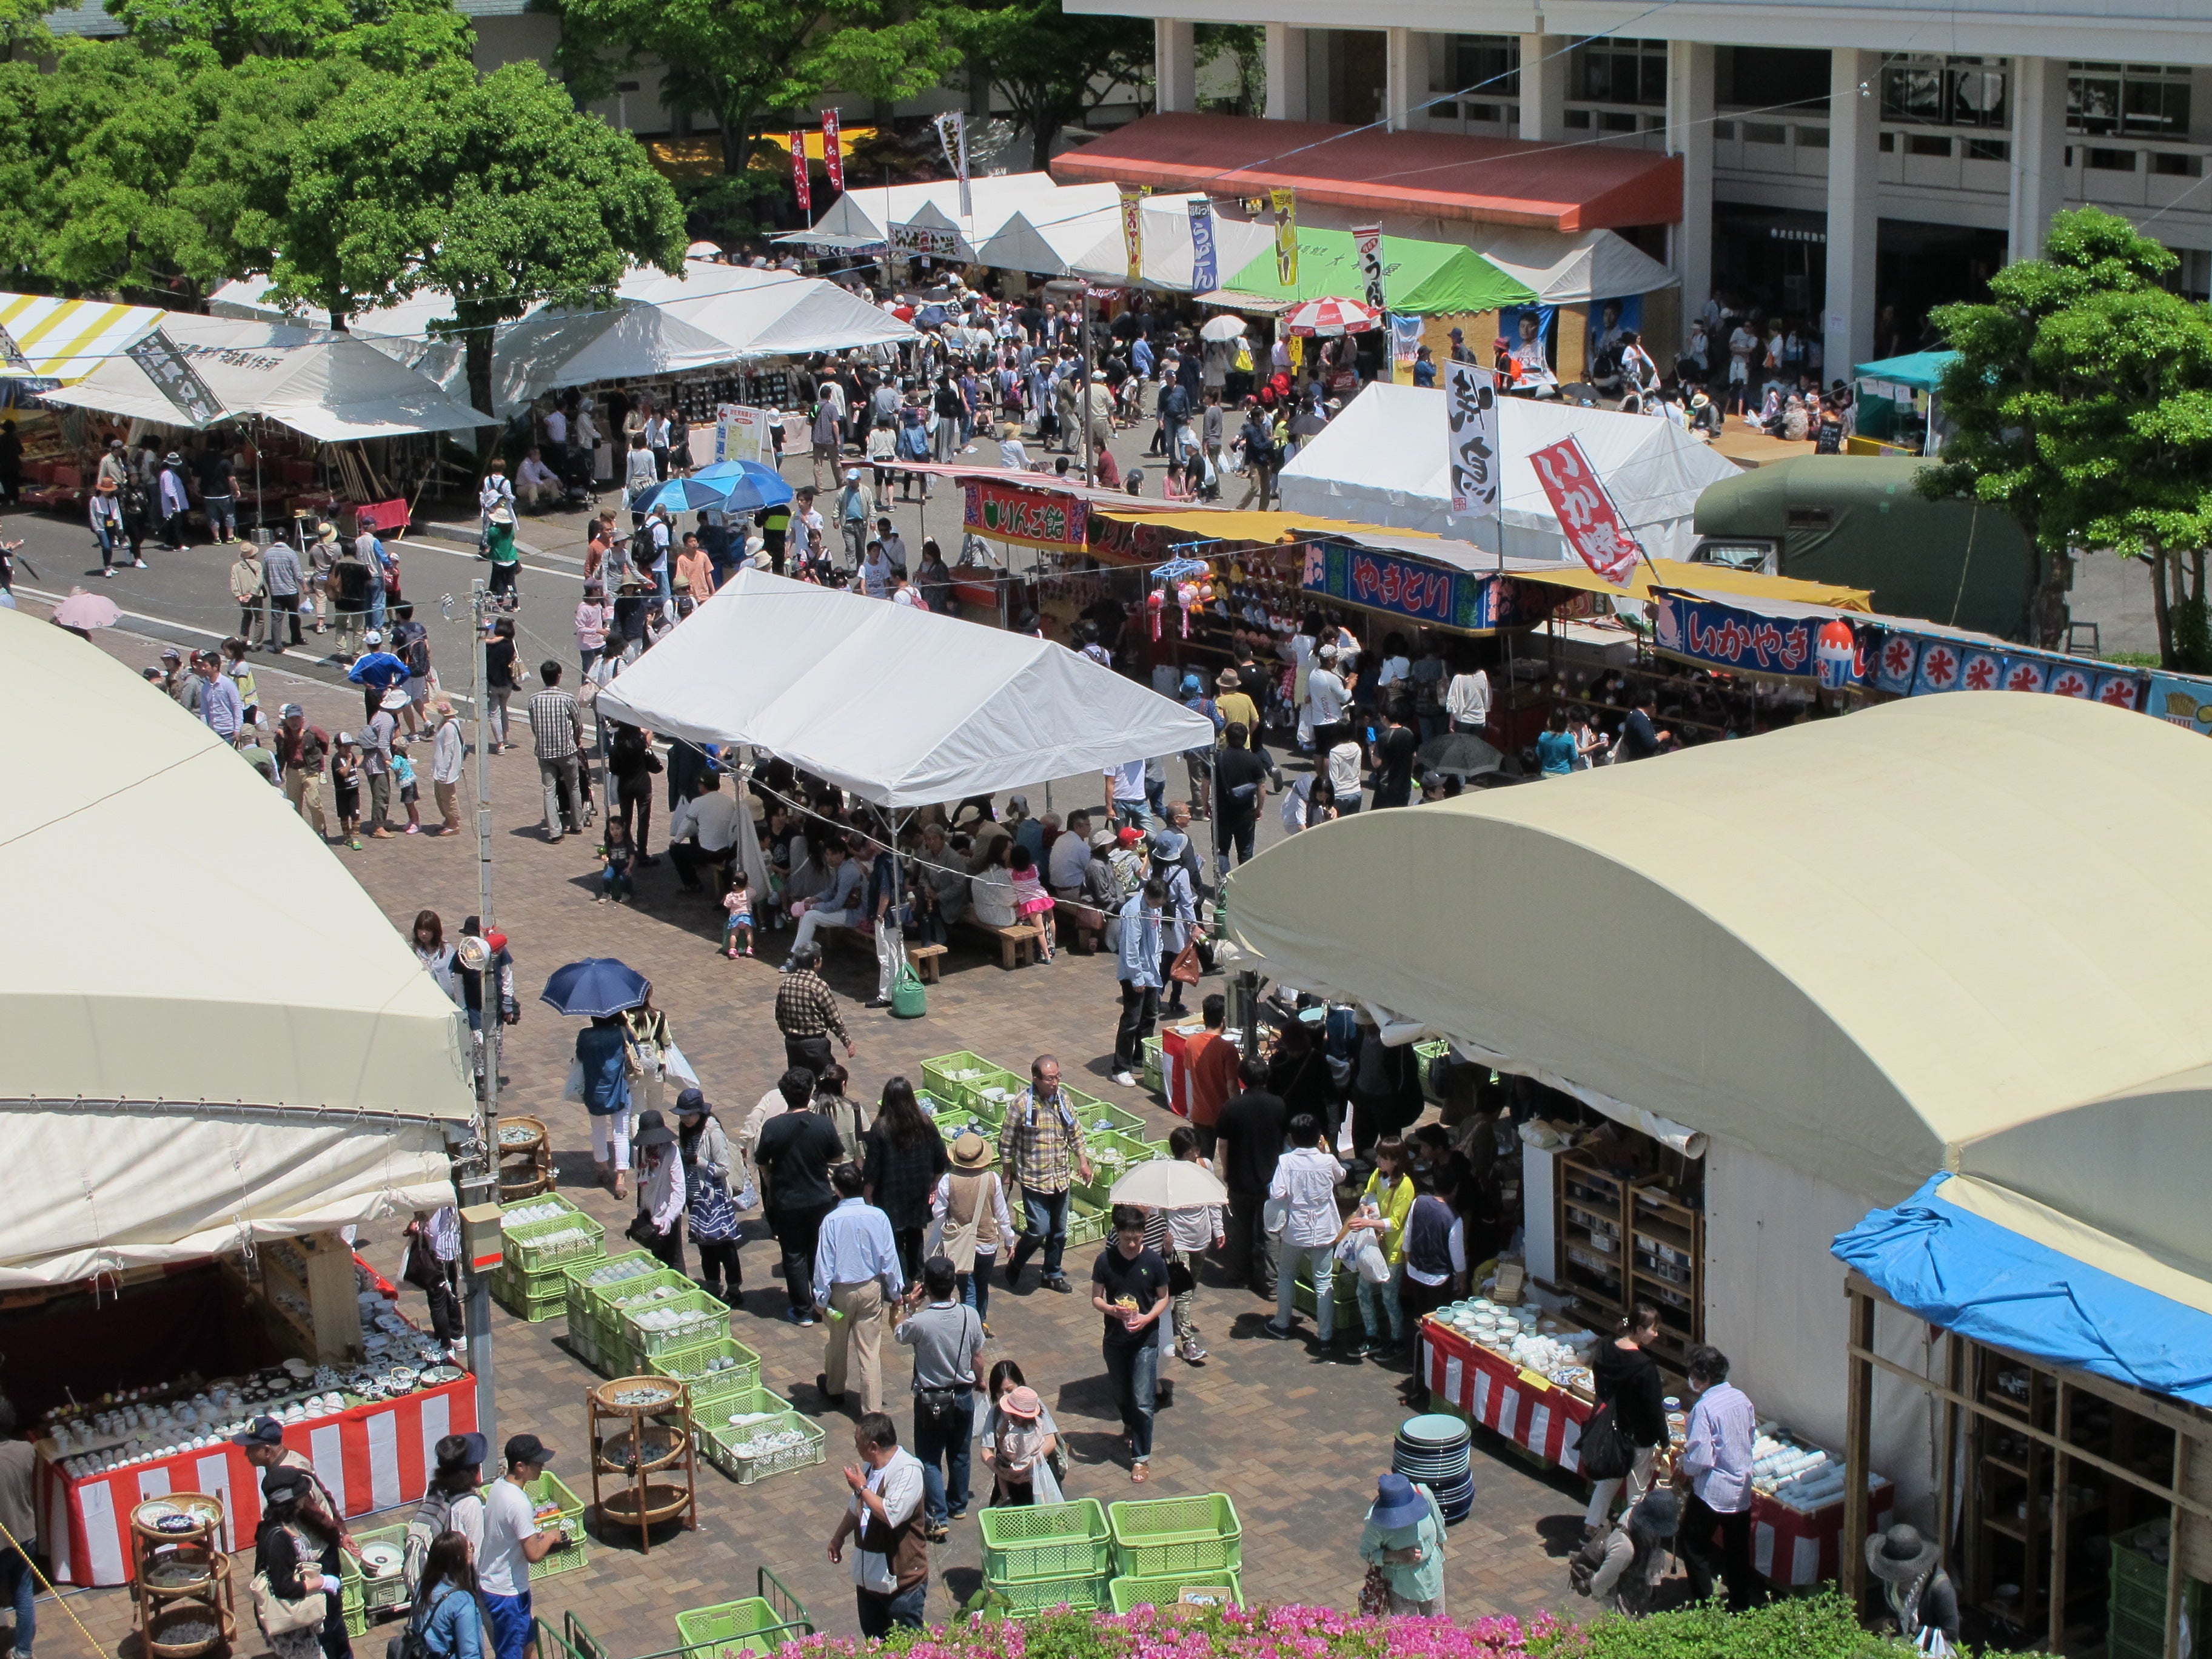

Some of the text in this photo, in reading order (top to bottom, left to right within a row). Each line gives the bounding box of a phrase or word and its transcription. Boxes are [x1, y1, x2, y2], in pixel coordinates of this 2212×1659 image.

[1193, 222, 1215, 290] うどん
[998, 496, 1067, 541] りんご飴
[1537, 446, 1632, 564] いか焼
[1353, 554, 1449, 618] やきとり
[1688, 611, 1809, 670] いかやき
[1885, 640, 1911, 676] 氷
[1926, 649, 1954, 685] 氷
[1966, 659, 1994, 691] 氷
